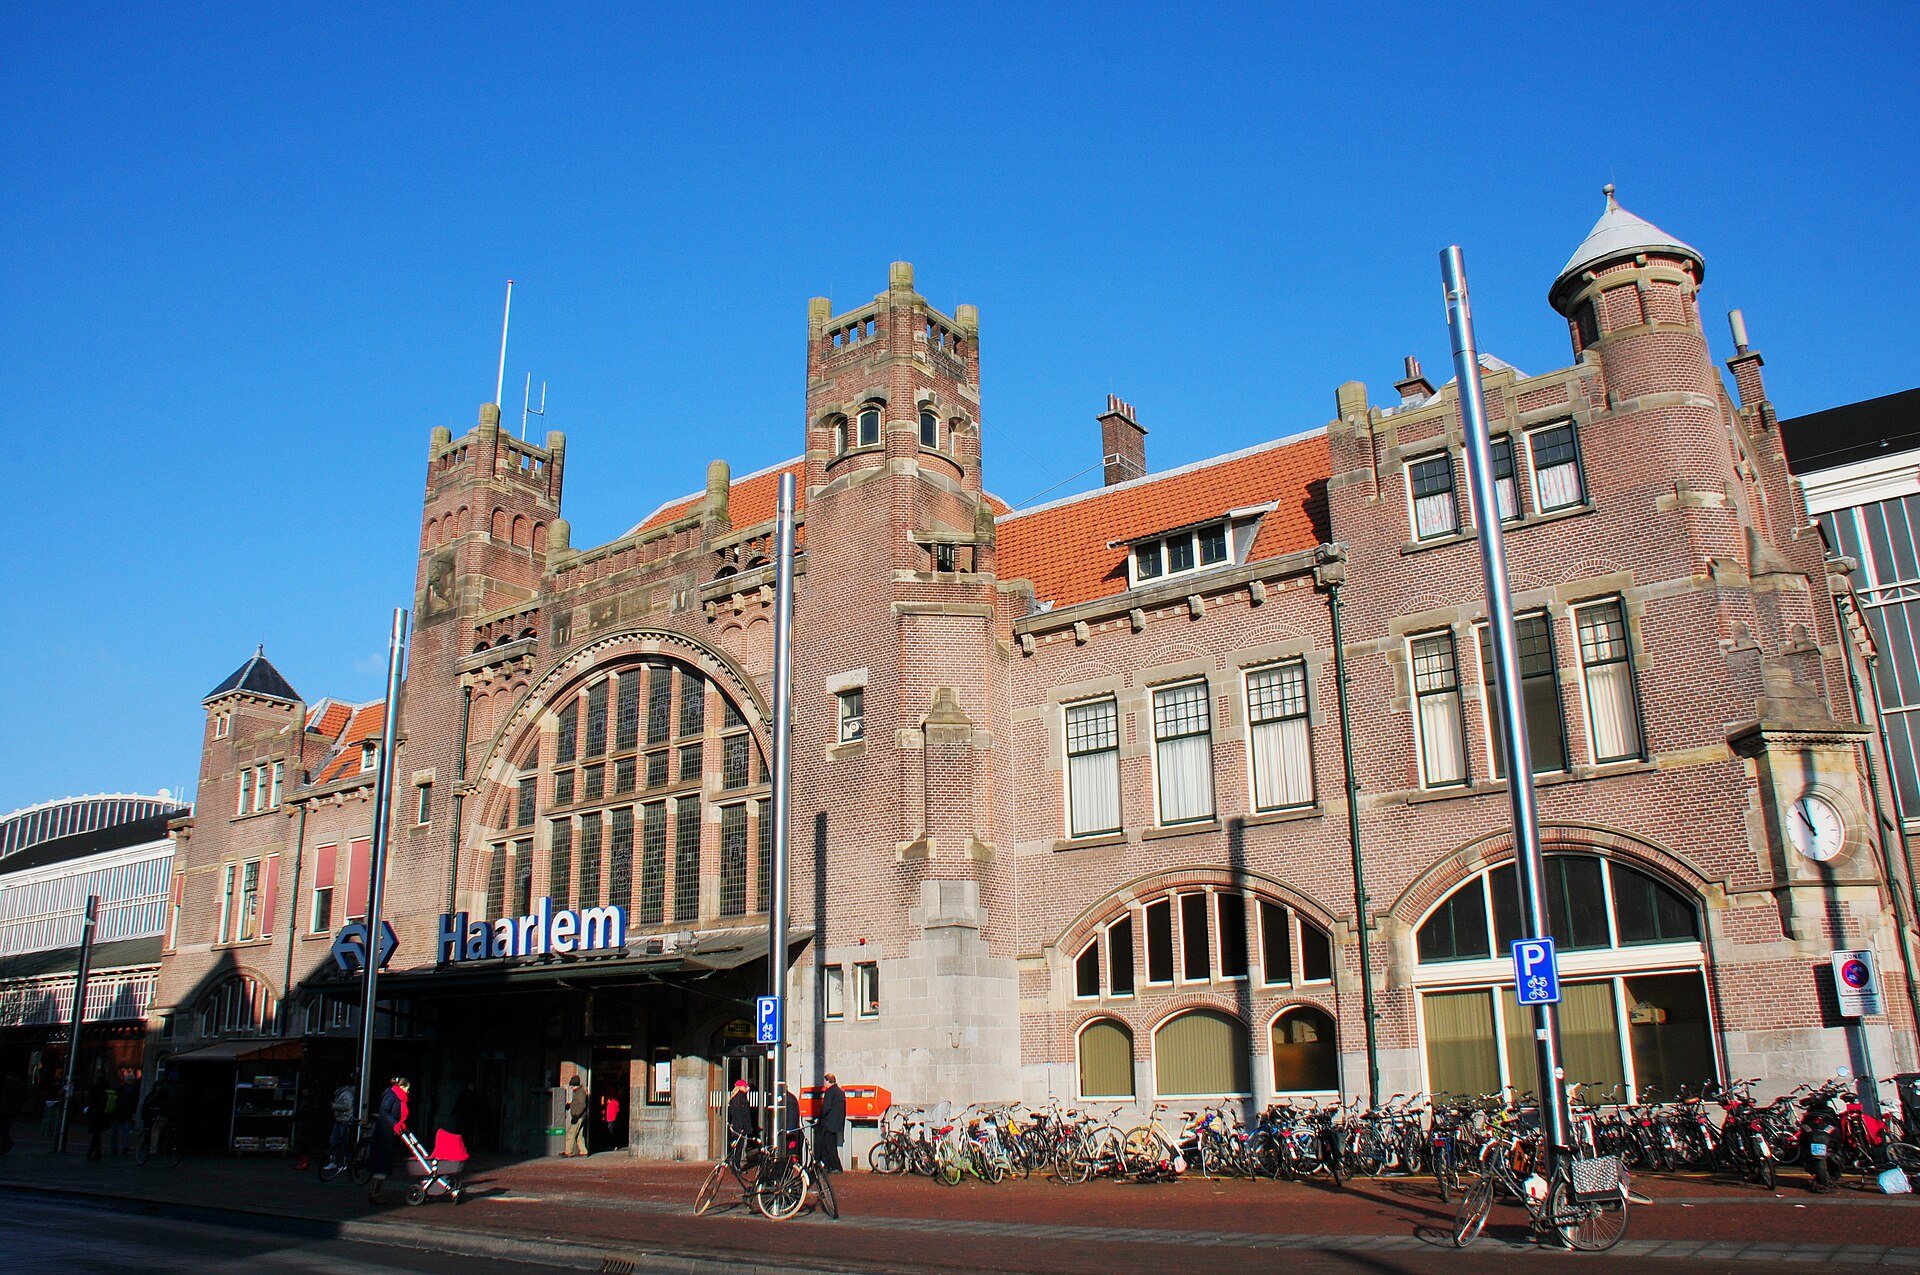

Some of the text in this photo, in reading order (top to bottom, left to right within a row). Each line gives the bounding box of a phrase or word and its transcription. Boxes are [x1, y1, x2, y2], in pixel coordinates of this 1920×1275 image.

[438, 897, 626, 963] Haarlem
[1522, 944, 1545, 976] P
[762, 1000, 774, 1024] P
